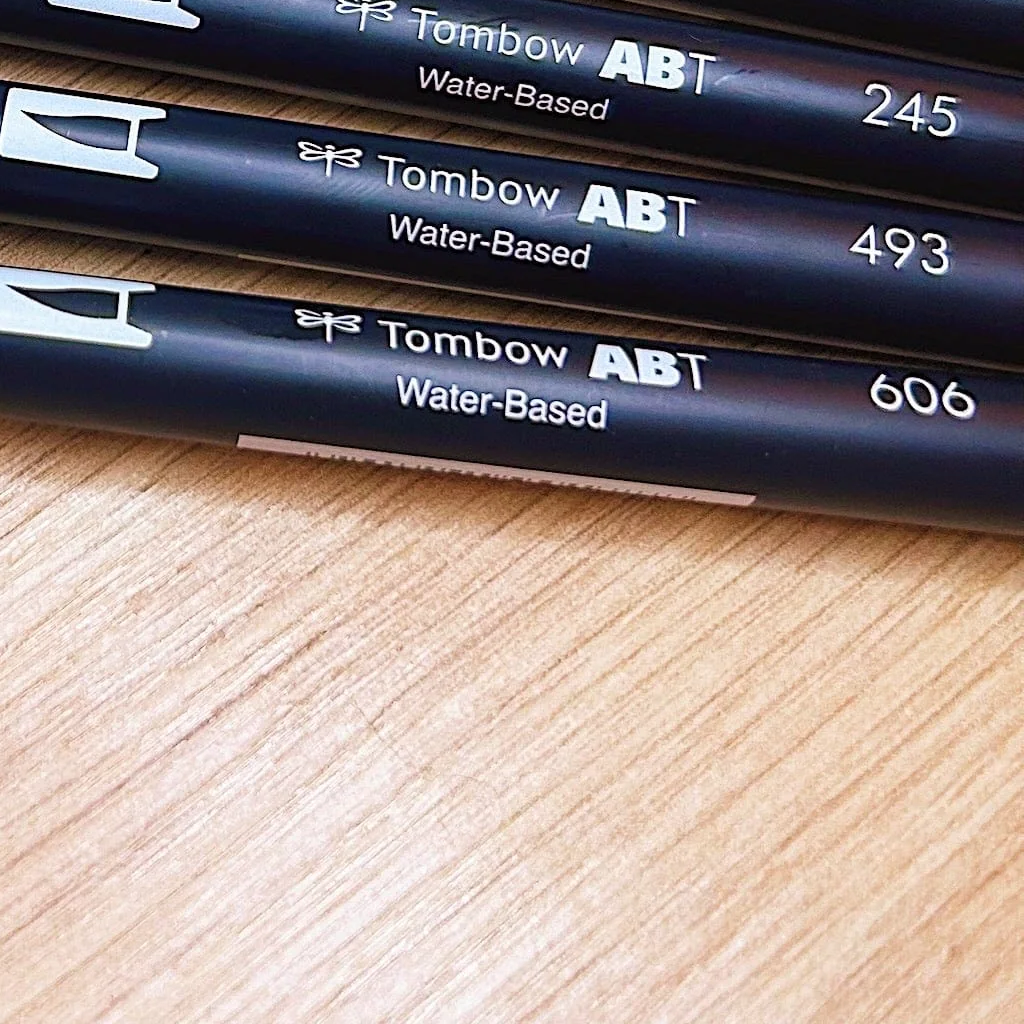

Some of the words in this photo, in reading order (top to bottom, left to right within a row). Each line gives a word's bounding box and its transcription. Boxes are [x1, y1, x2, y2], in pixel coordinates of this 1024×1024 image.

[410, 6, 585, 66] Tombow
[598, 39, 718, 95] ABT
[862, 83, 957, 137] 245
[419, 66, 610, 120] Water-Based
[377, 154, 561, 211] Tombow
[576, 184, 697, 238] ABT
[849, 224, 949, 275] 493
[389, 213, 591, 270] Water-Based
[377, 319, 568, 369] Tombow
[588, 343, 707, 391] ABT
[870, 373, 976, 420] 606
[395, 375, 609, 430] Water-Based
